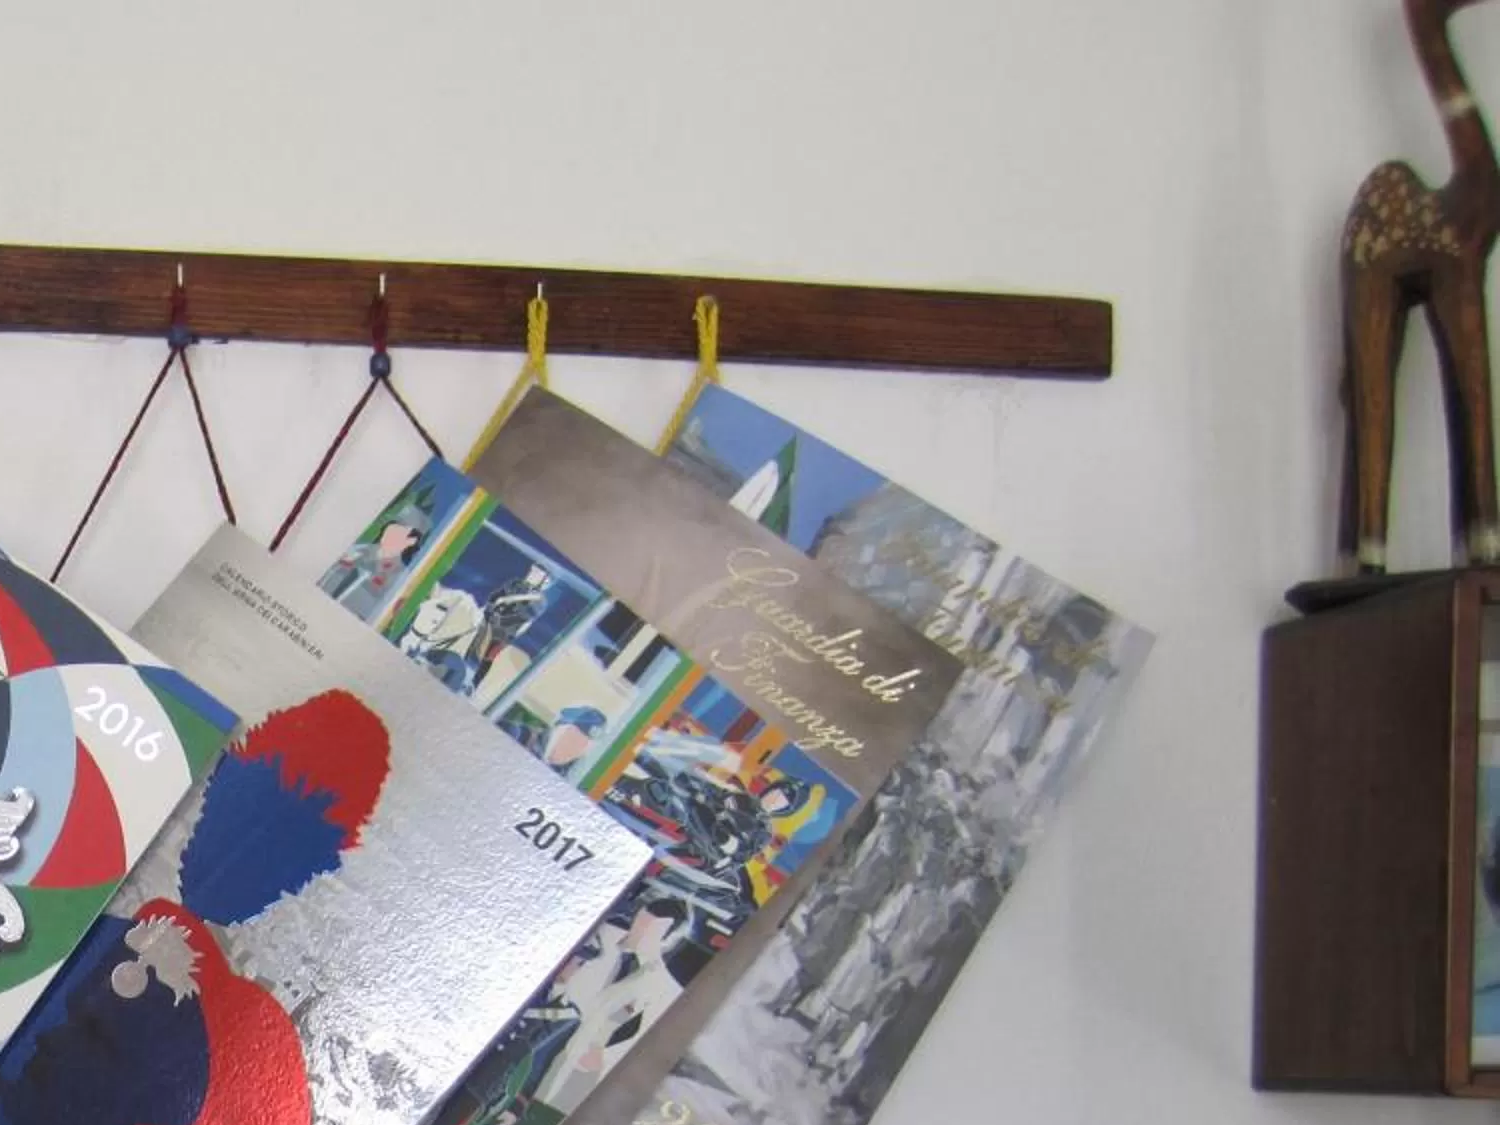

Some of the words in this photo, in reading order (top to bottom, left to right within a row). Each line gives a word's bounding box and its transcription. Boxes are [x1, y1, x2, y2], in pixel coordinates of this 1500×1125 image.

[861, 668, 922, 703] di
[73, 684, 164, 762] 2016
[514, 807, 595, 872] 2017
